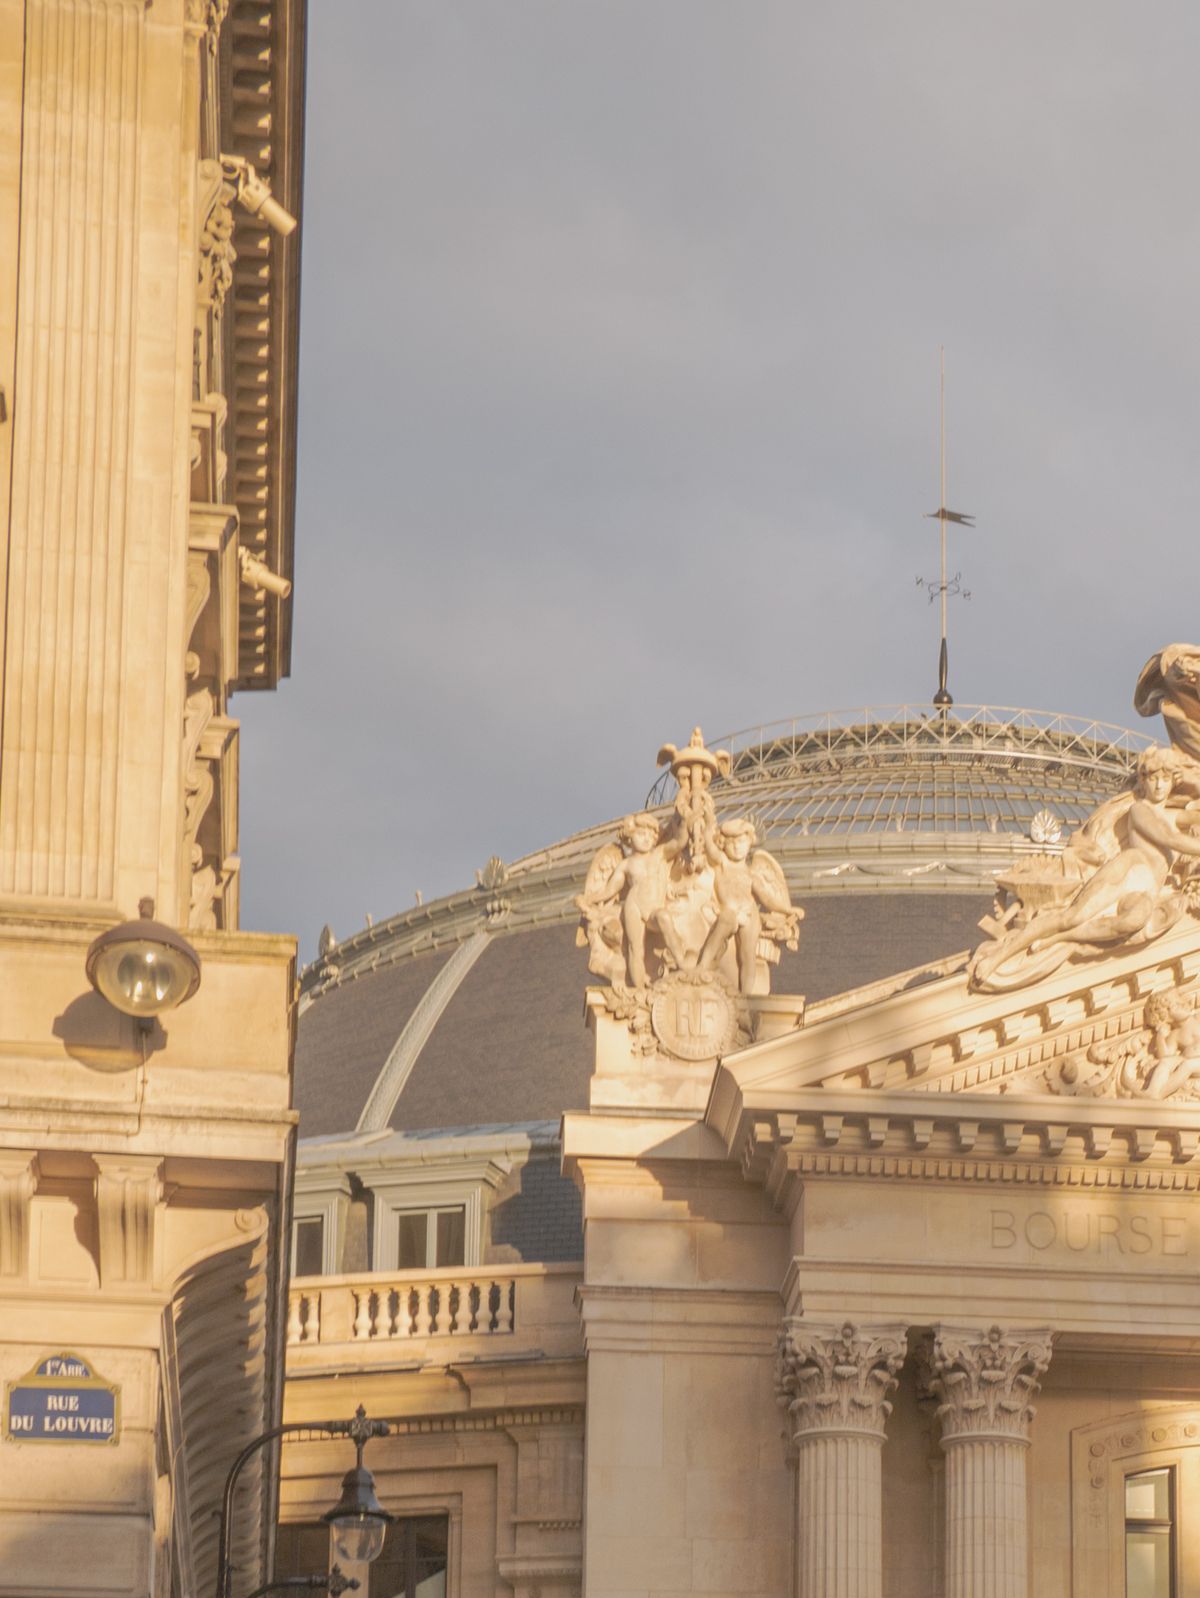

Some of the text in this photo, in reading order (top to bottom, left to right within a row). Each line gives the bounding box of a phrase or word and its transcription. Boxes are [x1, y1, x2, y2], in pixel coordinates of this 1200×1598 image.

[990, 1209, 1188, 1257] BOURSE
[47, 1395, 79, 1411] RUE
[10, 1415, 113, 1433] DU LOUVRE
